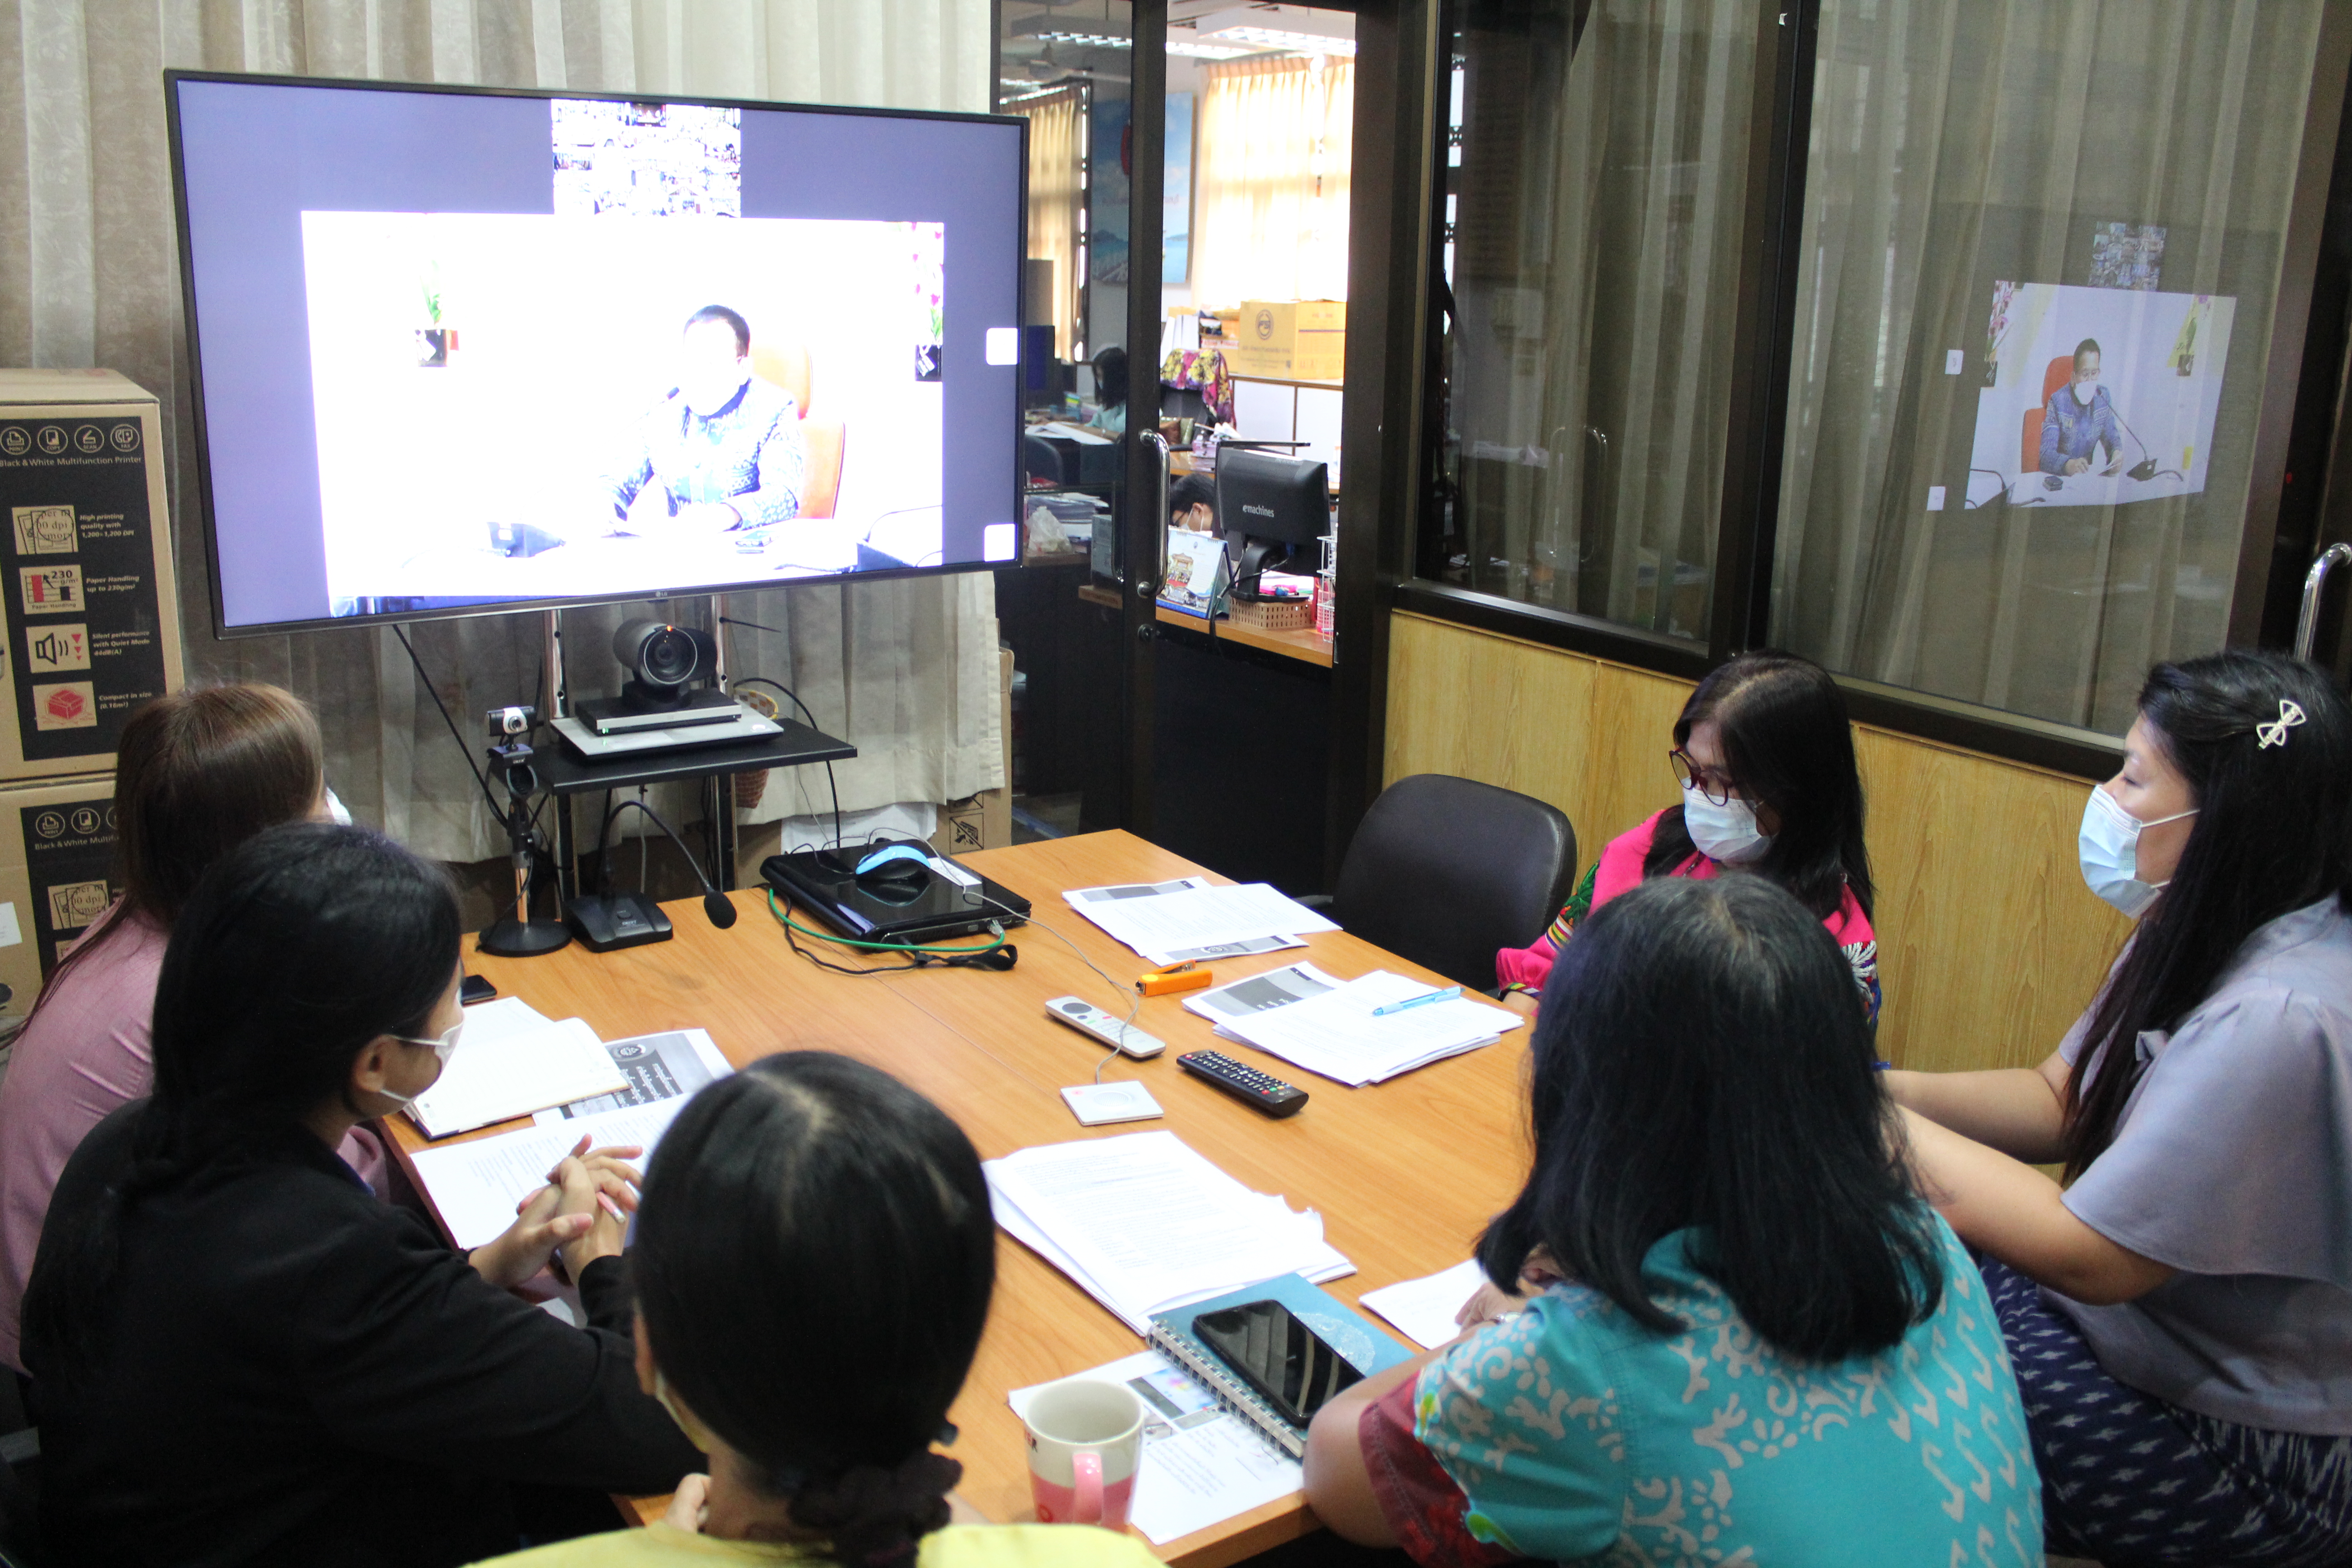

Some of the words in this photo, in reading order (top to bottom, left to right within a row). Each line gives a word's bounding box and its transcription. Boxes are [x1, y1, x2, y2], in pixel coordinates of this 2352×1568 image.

[29, 458, 54, 466] White
[57, 457, 113, 466] Multifunction
[1242, 505, 1274, 518] emachines
[97, 513, 124, 521] printing
[52, 520, 68, 531] dpi
[51, 570, 73, 579] 230
[64, 839, 88, 847] White
[86, 896, 101, 905] dpi
